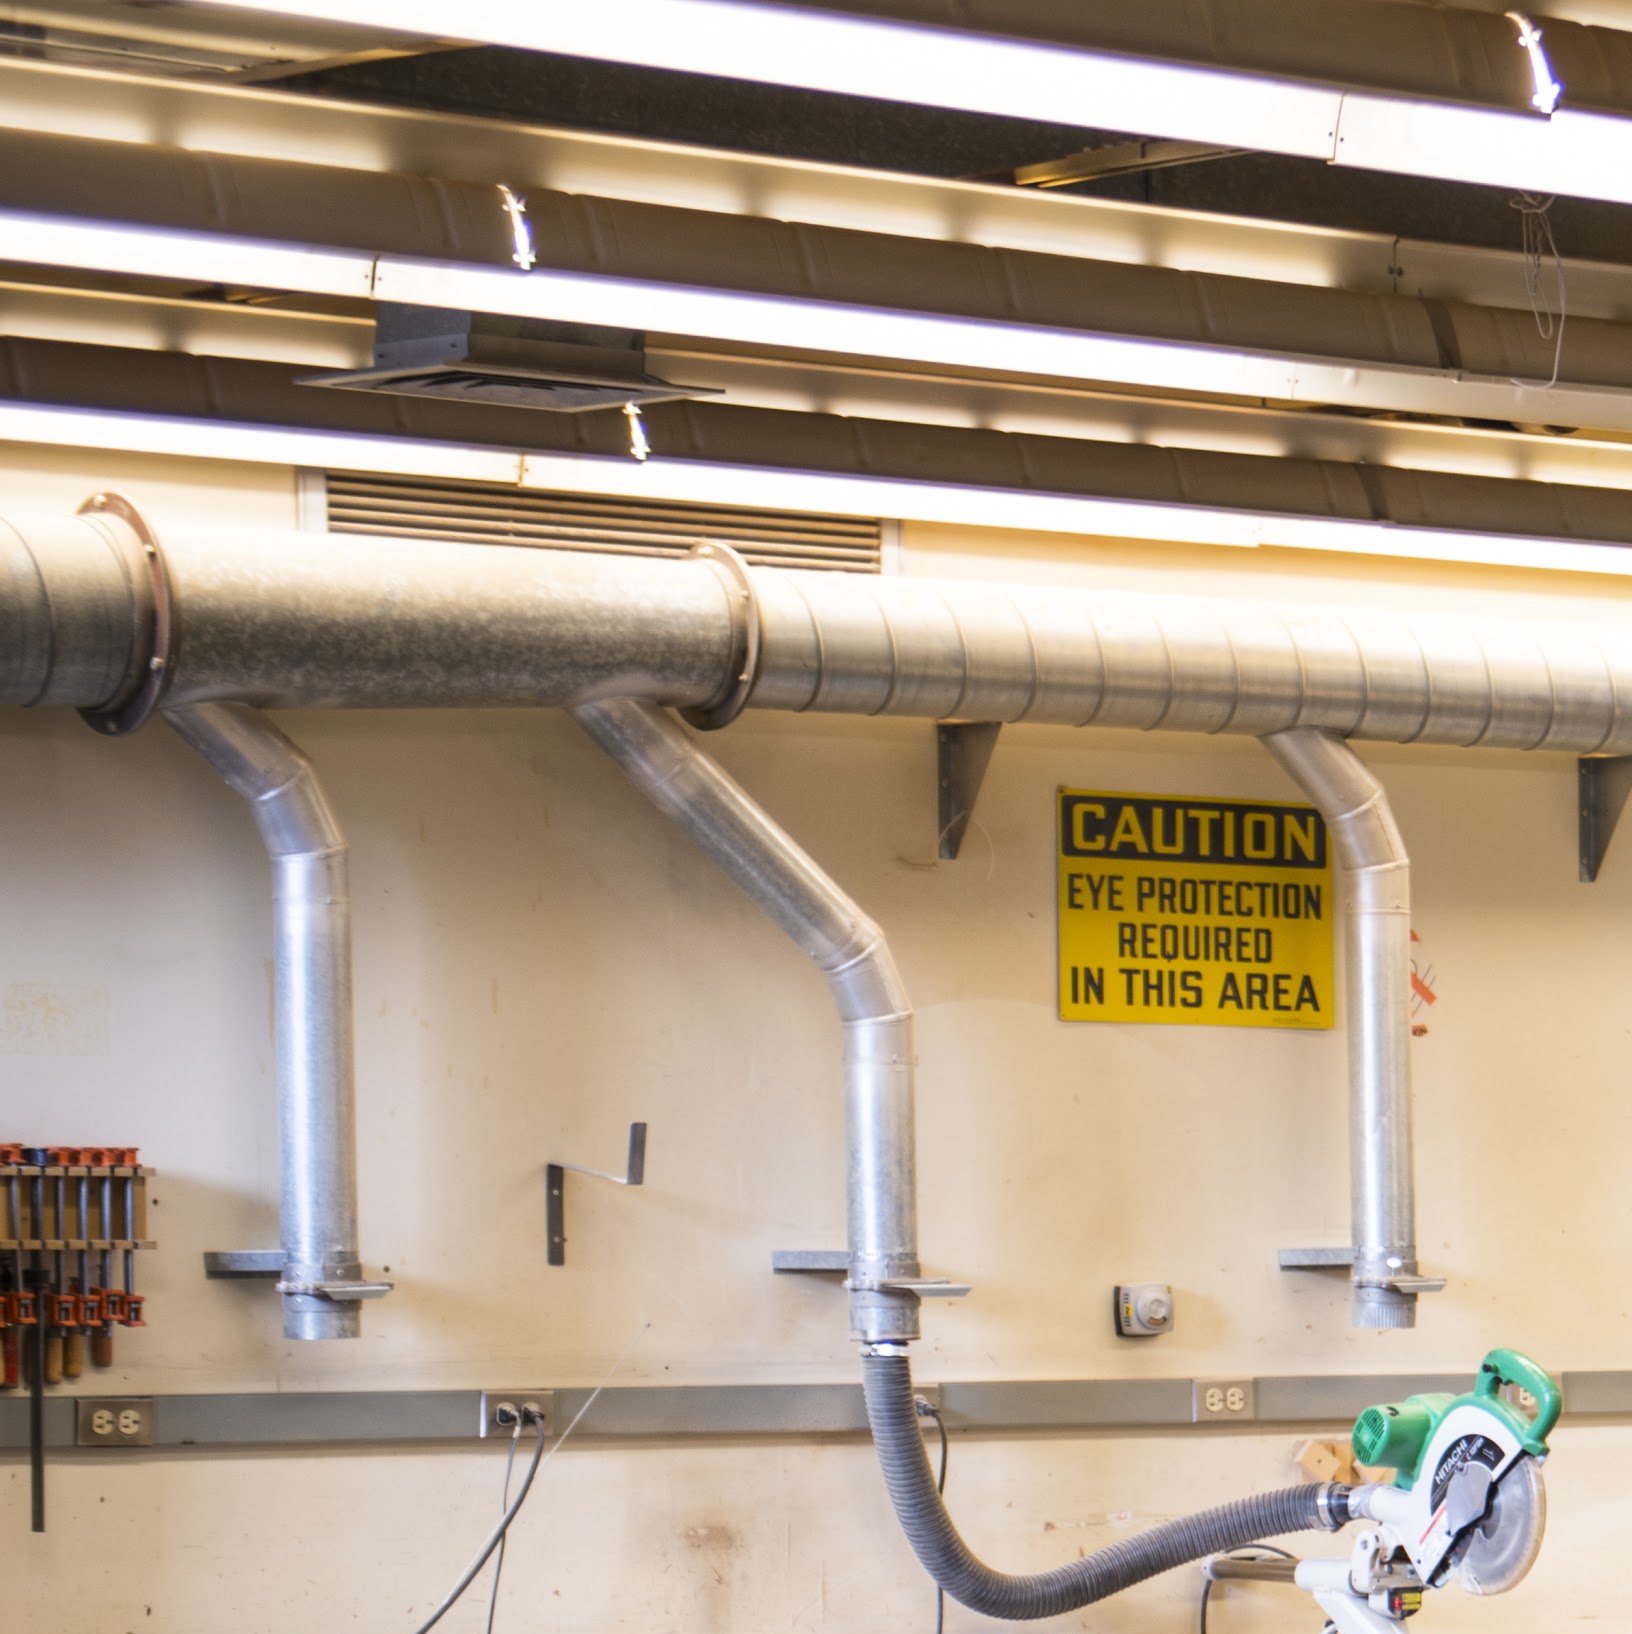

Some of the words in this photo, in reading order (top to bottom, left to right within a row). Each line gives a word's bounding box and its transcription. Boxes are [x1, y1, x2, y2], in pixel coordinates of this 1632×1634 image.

[1071, 802, 1317, 862] CAUTION
[1067, 873, 1124, 912] EYE
[1136, 876, 1322, 920] PROTECTION
[1118, 922, 1273, 963] REQUIRED
[1070, 966, 1105, 1005] IN
[1118, 968, 1203, 1009] THIS
[1217, 972, 1321, 1012] AREA
[1434, 1439, 1469, 1485] HITACHI
